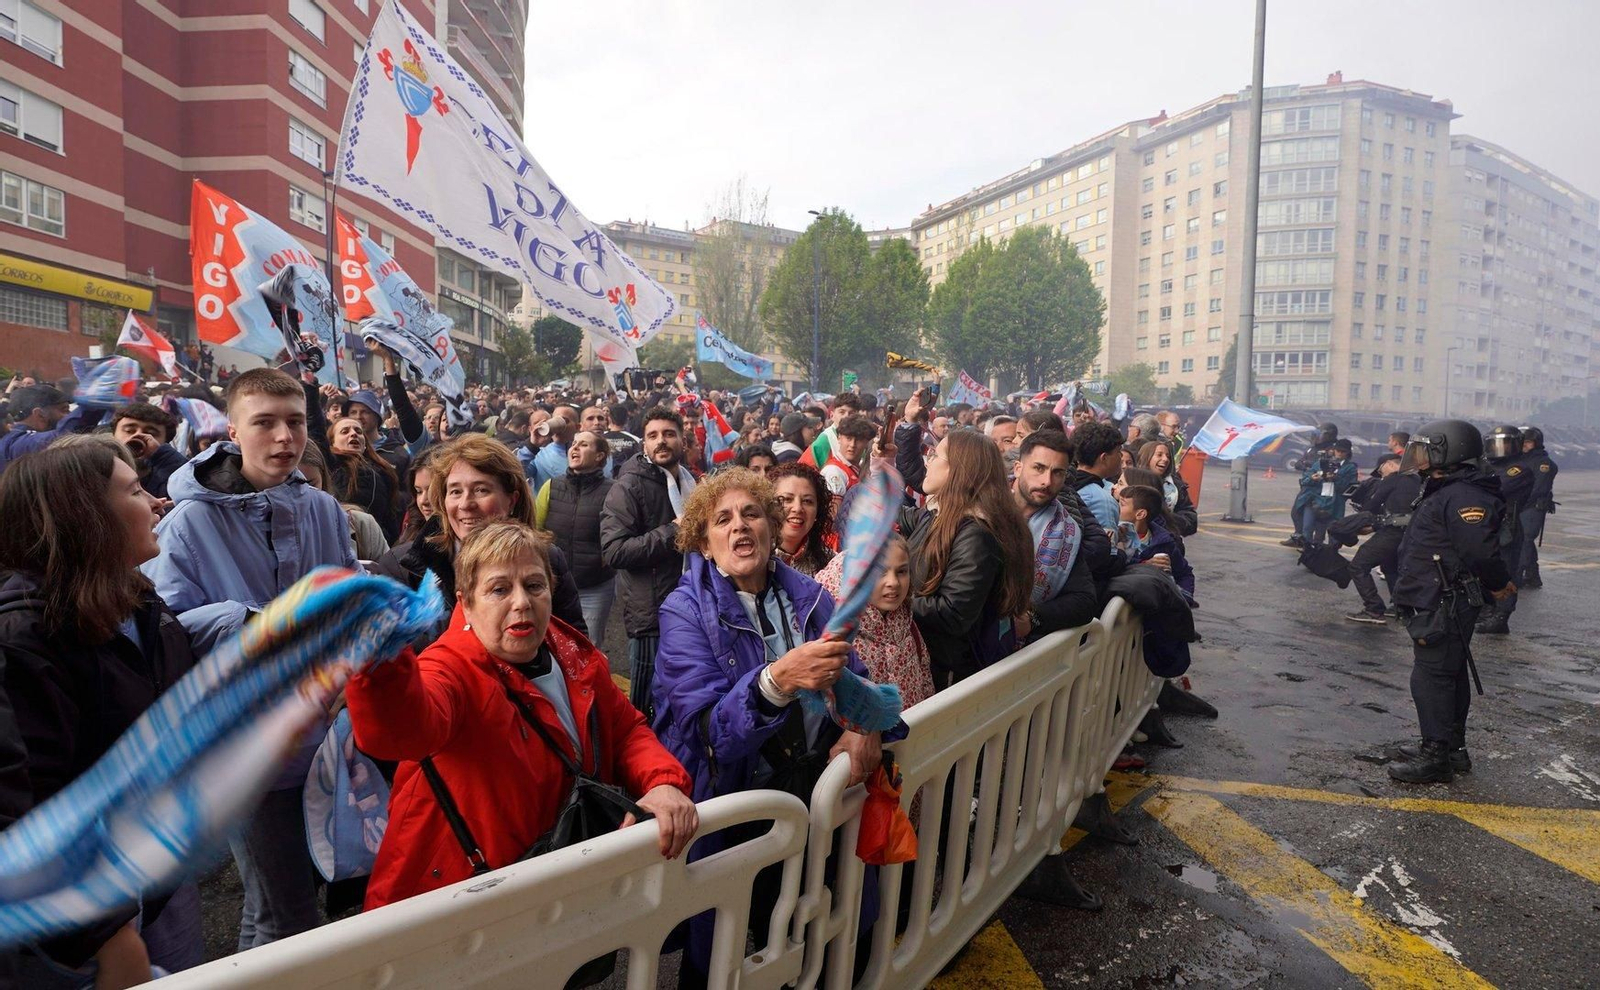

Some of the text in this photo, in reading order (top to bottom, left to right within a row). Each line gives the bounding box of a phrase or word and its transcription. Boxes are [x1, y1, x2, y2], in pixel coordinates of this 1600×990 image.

[96, 286, 133, 302] CORREOS
[197, 198, 229, 320] VIGO
[482, 182, 606, 299] VIGO
